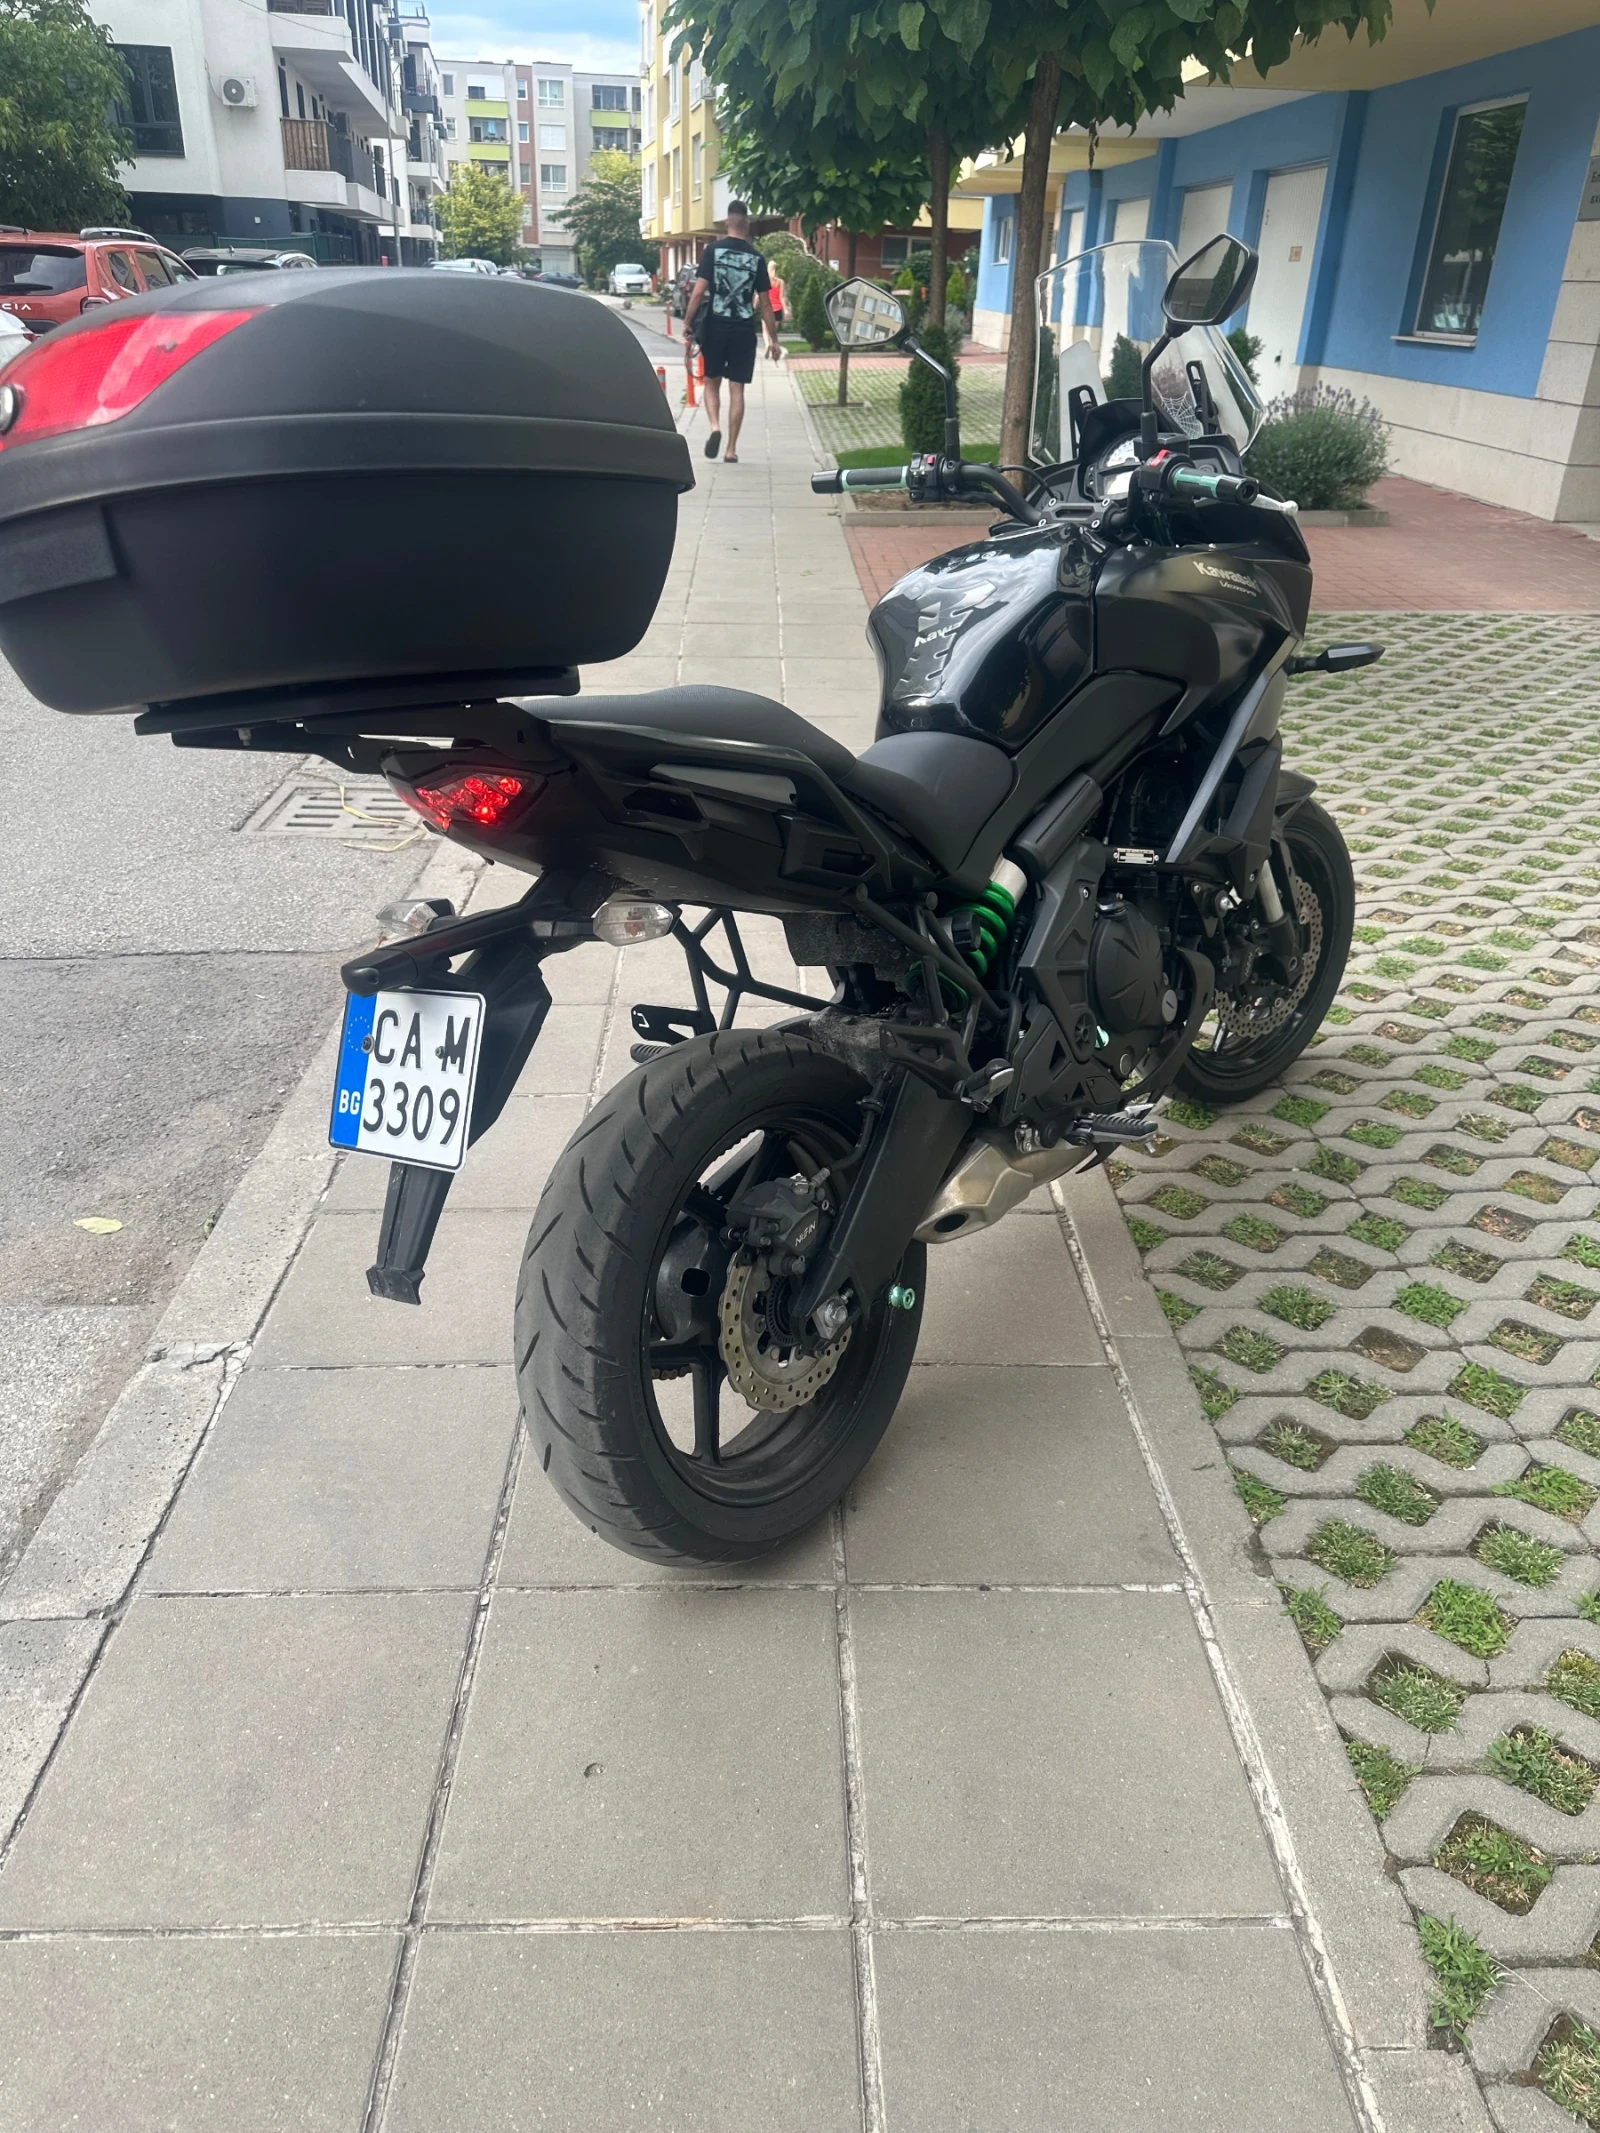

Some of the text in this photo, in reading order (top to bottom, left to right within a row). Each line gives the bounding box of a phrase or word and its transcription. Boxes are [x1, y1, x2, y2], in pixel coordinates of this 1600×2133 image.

[373, 1008, 472, 1075] CA M
[337, 1088, 362, 1117] BG
[362, 1077, 461, 1146] 3309
